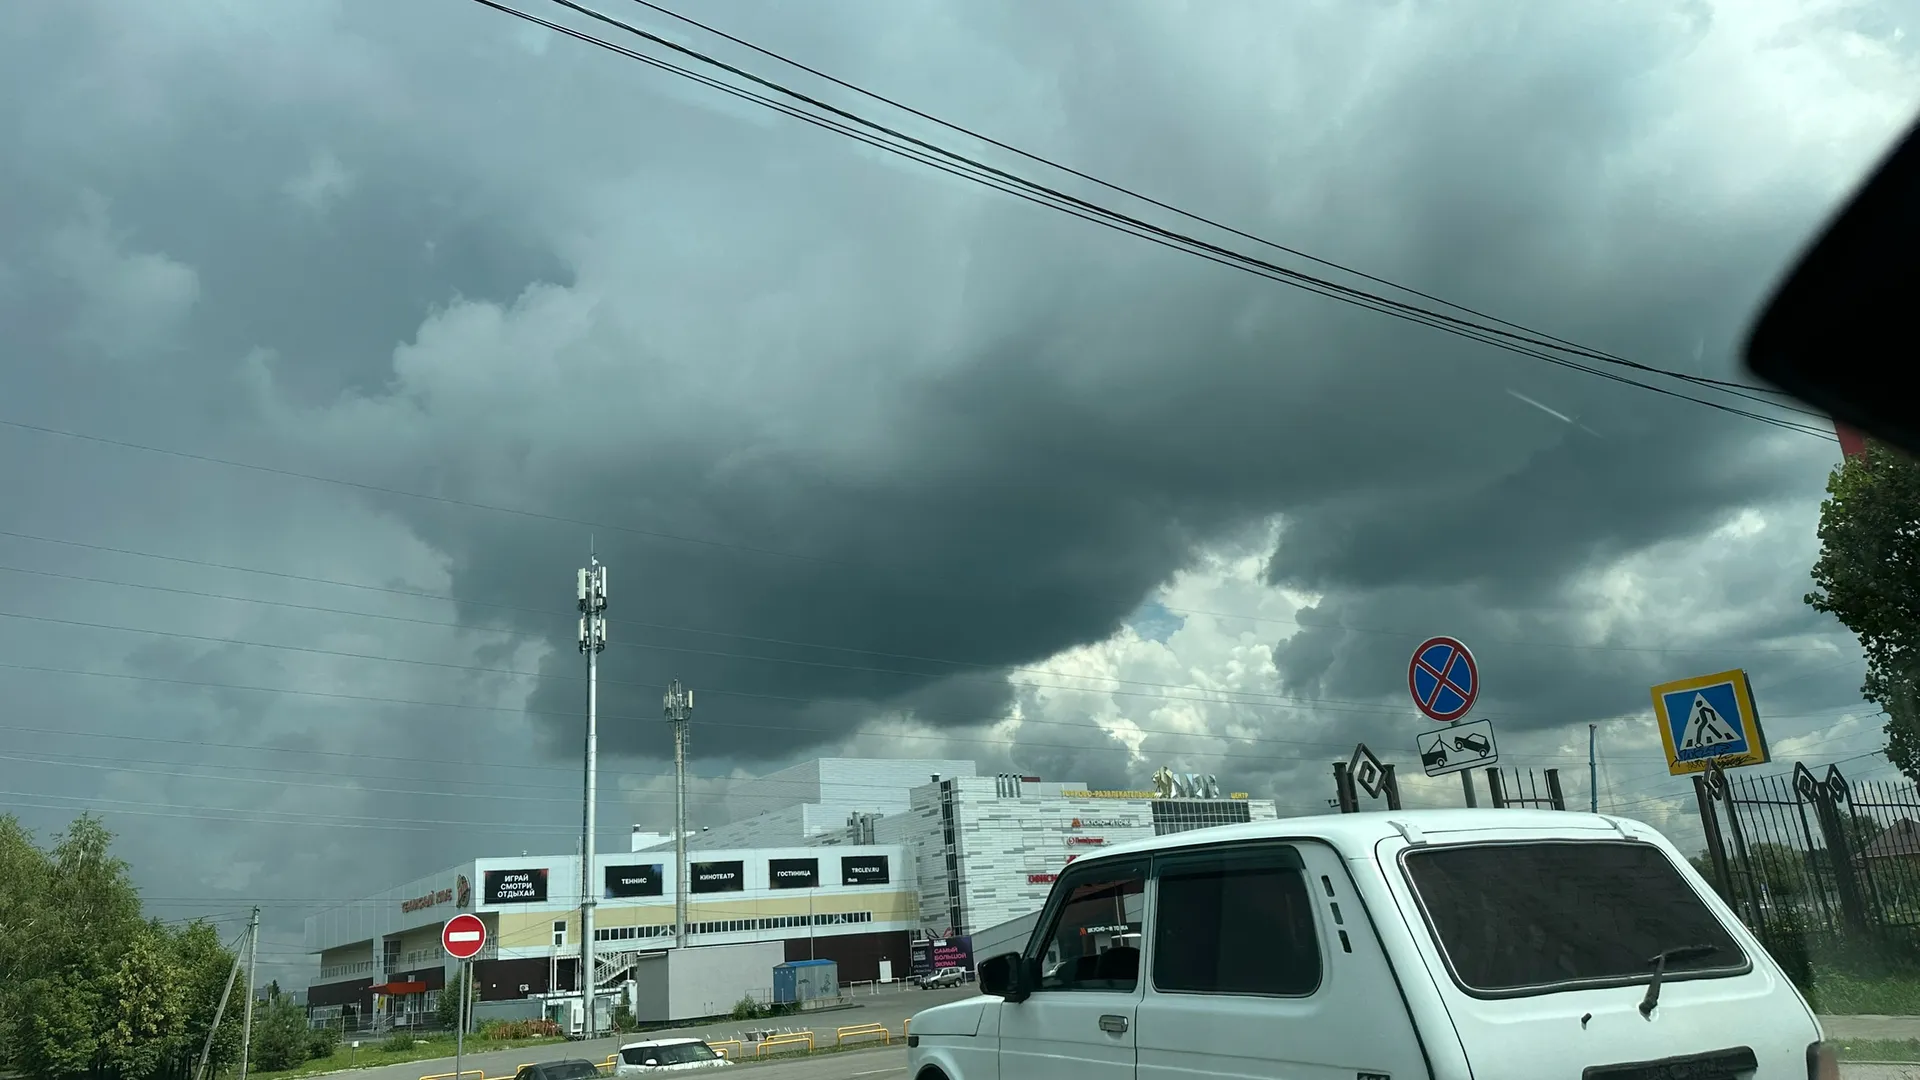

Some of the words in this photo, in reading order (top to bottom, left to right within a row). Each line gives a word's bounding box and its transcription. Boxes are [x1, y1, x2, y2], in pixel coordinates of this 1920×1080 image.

[700, 873, 735, 881] КИНОТЕАТР
[777, 870, 811, 878] ГОСТИНИЦА
[504, 874, 528, 883] ИГРАЙ
[621, 877, 647, 885] ТЕННИС
[500, 882, 532, 890] СМОТРИ
[497, 888, 535, 898] ОТДЫХАЙ
[934, 946, 958, 954] САМЫЙ
[934, 952, 967, 961] БОЛЬШОЙ
[935, 960, 956, 968] ЭКРАН
